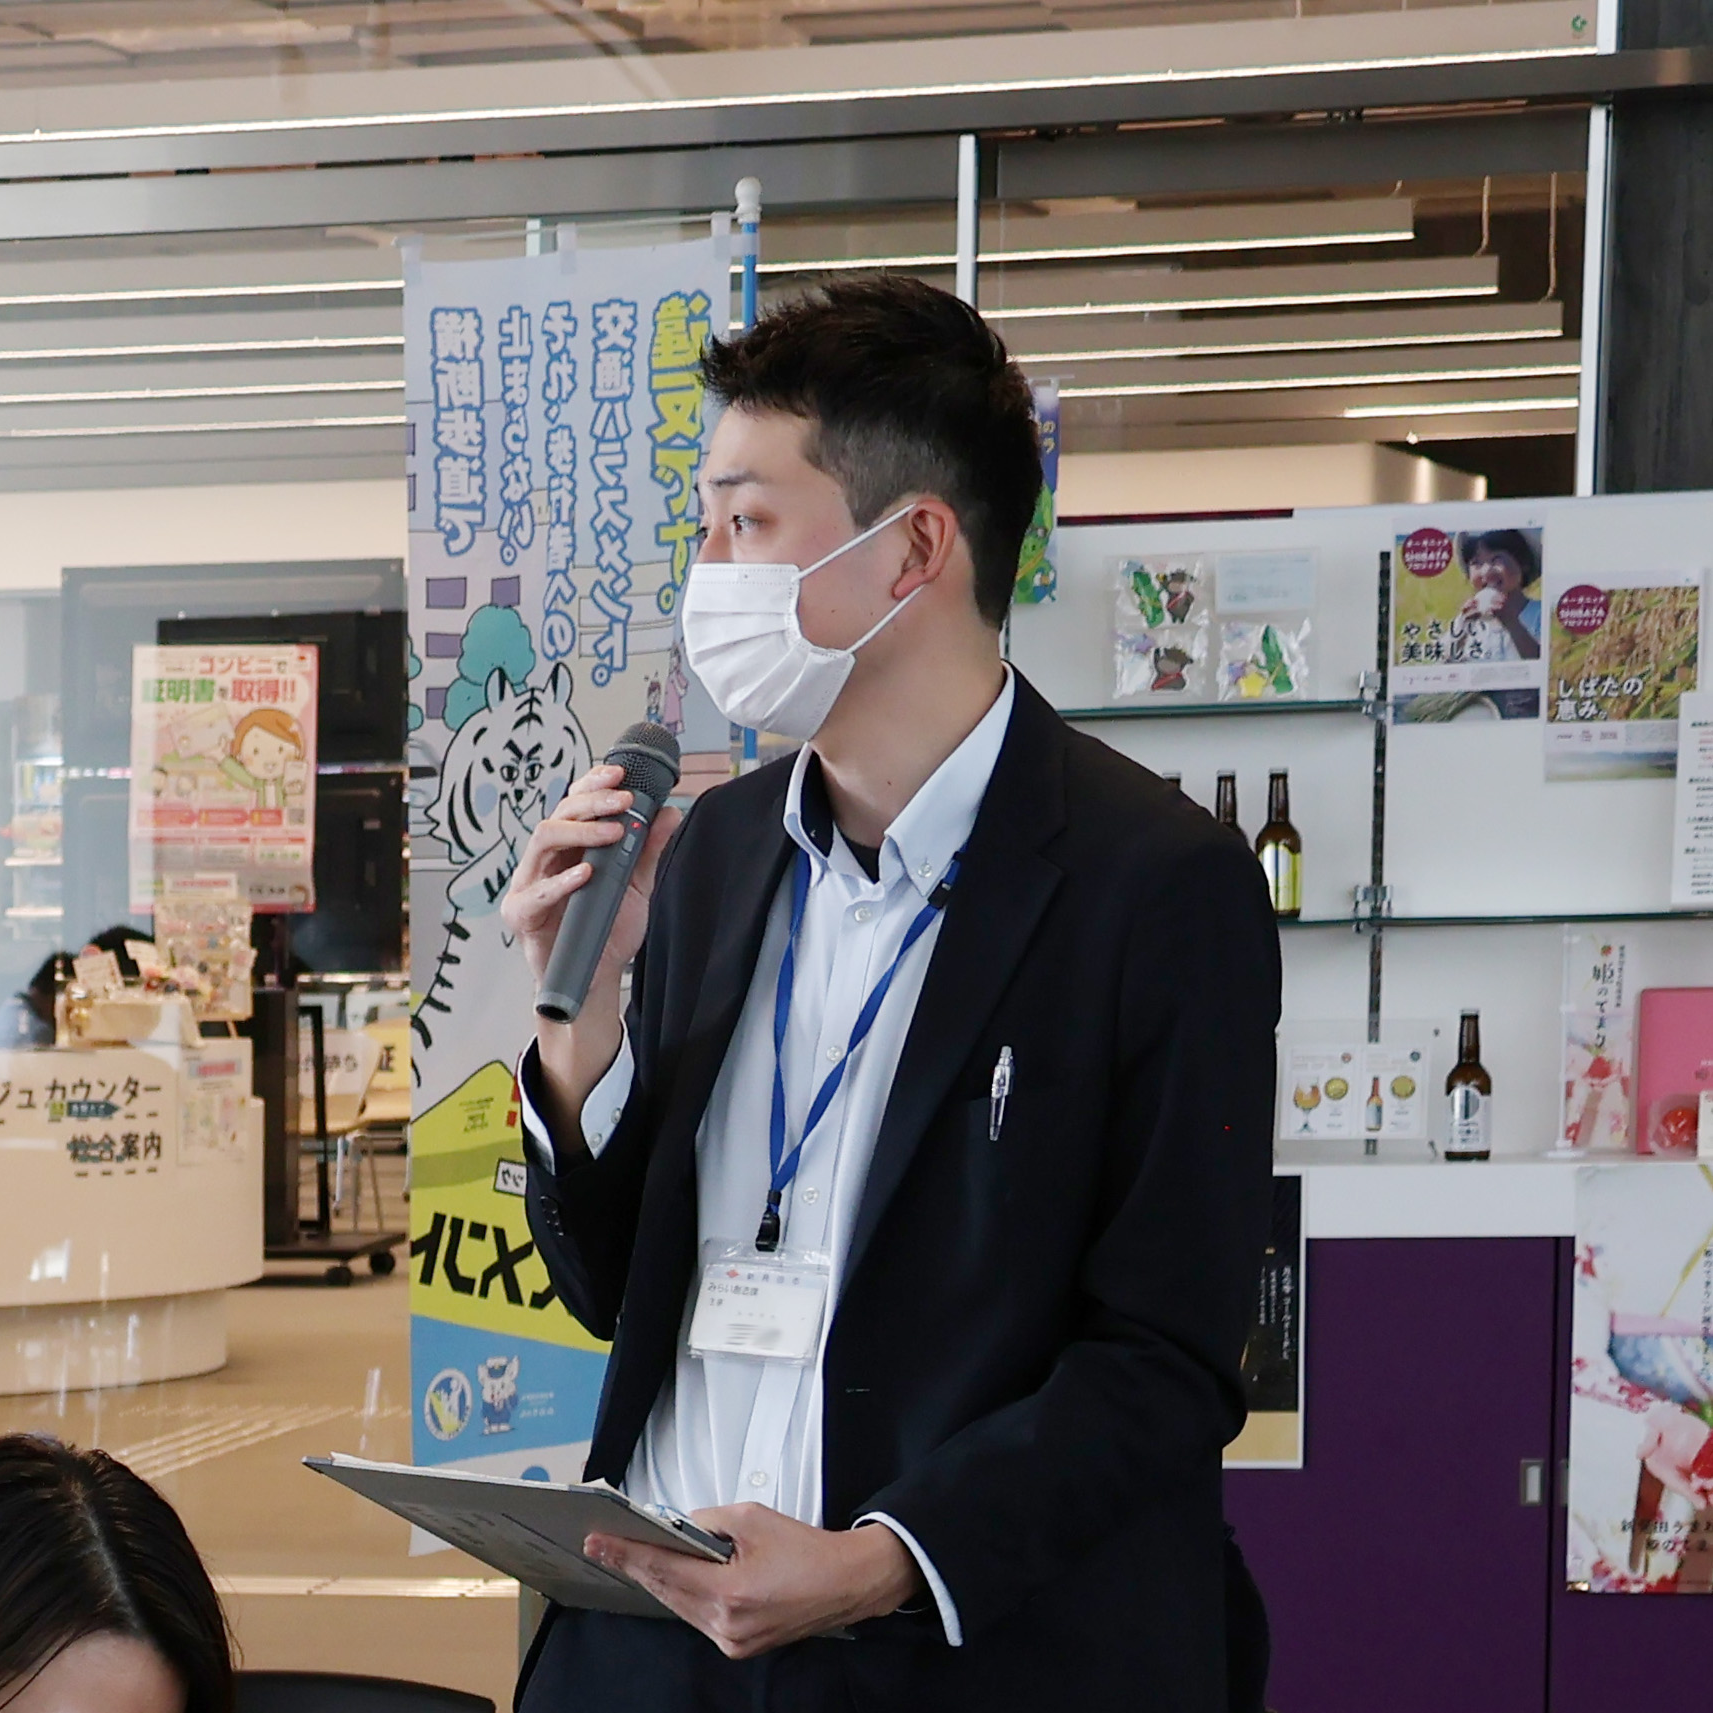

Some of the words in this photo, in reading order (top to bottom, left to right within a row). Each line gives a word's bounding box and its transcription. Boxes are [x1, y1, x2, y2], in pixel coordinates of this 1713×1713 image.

[1402, 621, 1488, 641] やさしい
[1401, 641, 1492, 663] 美味しさ。
[198, 654, 287, 675] コンビニで
[1559, 677, 1644, 699] しばたの
[1555, 699, 1608, 721] 恵み。
